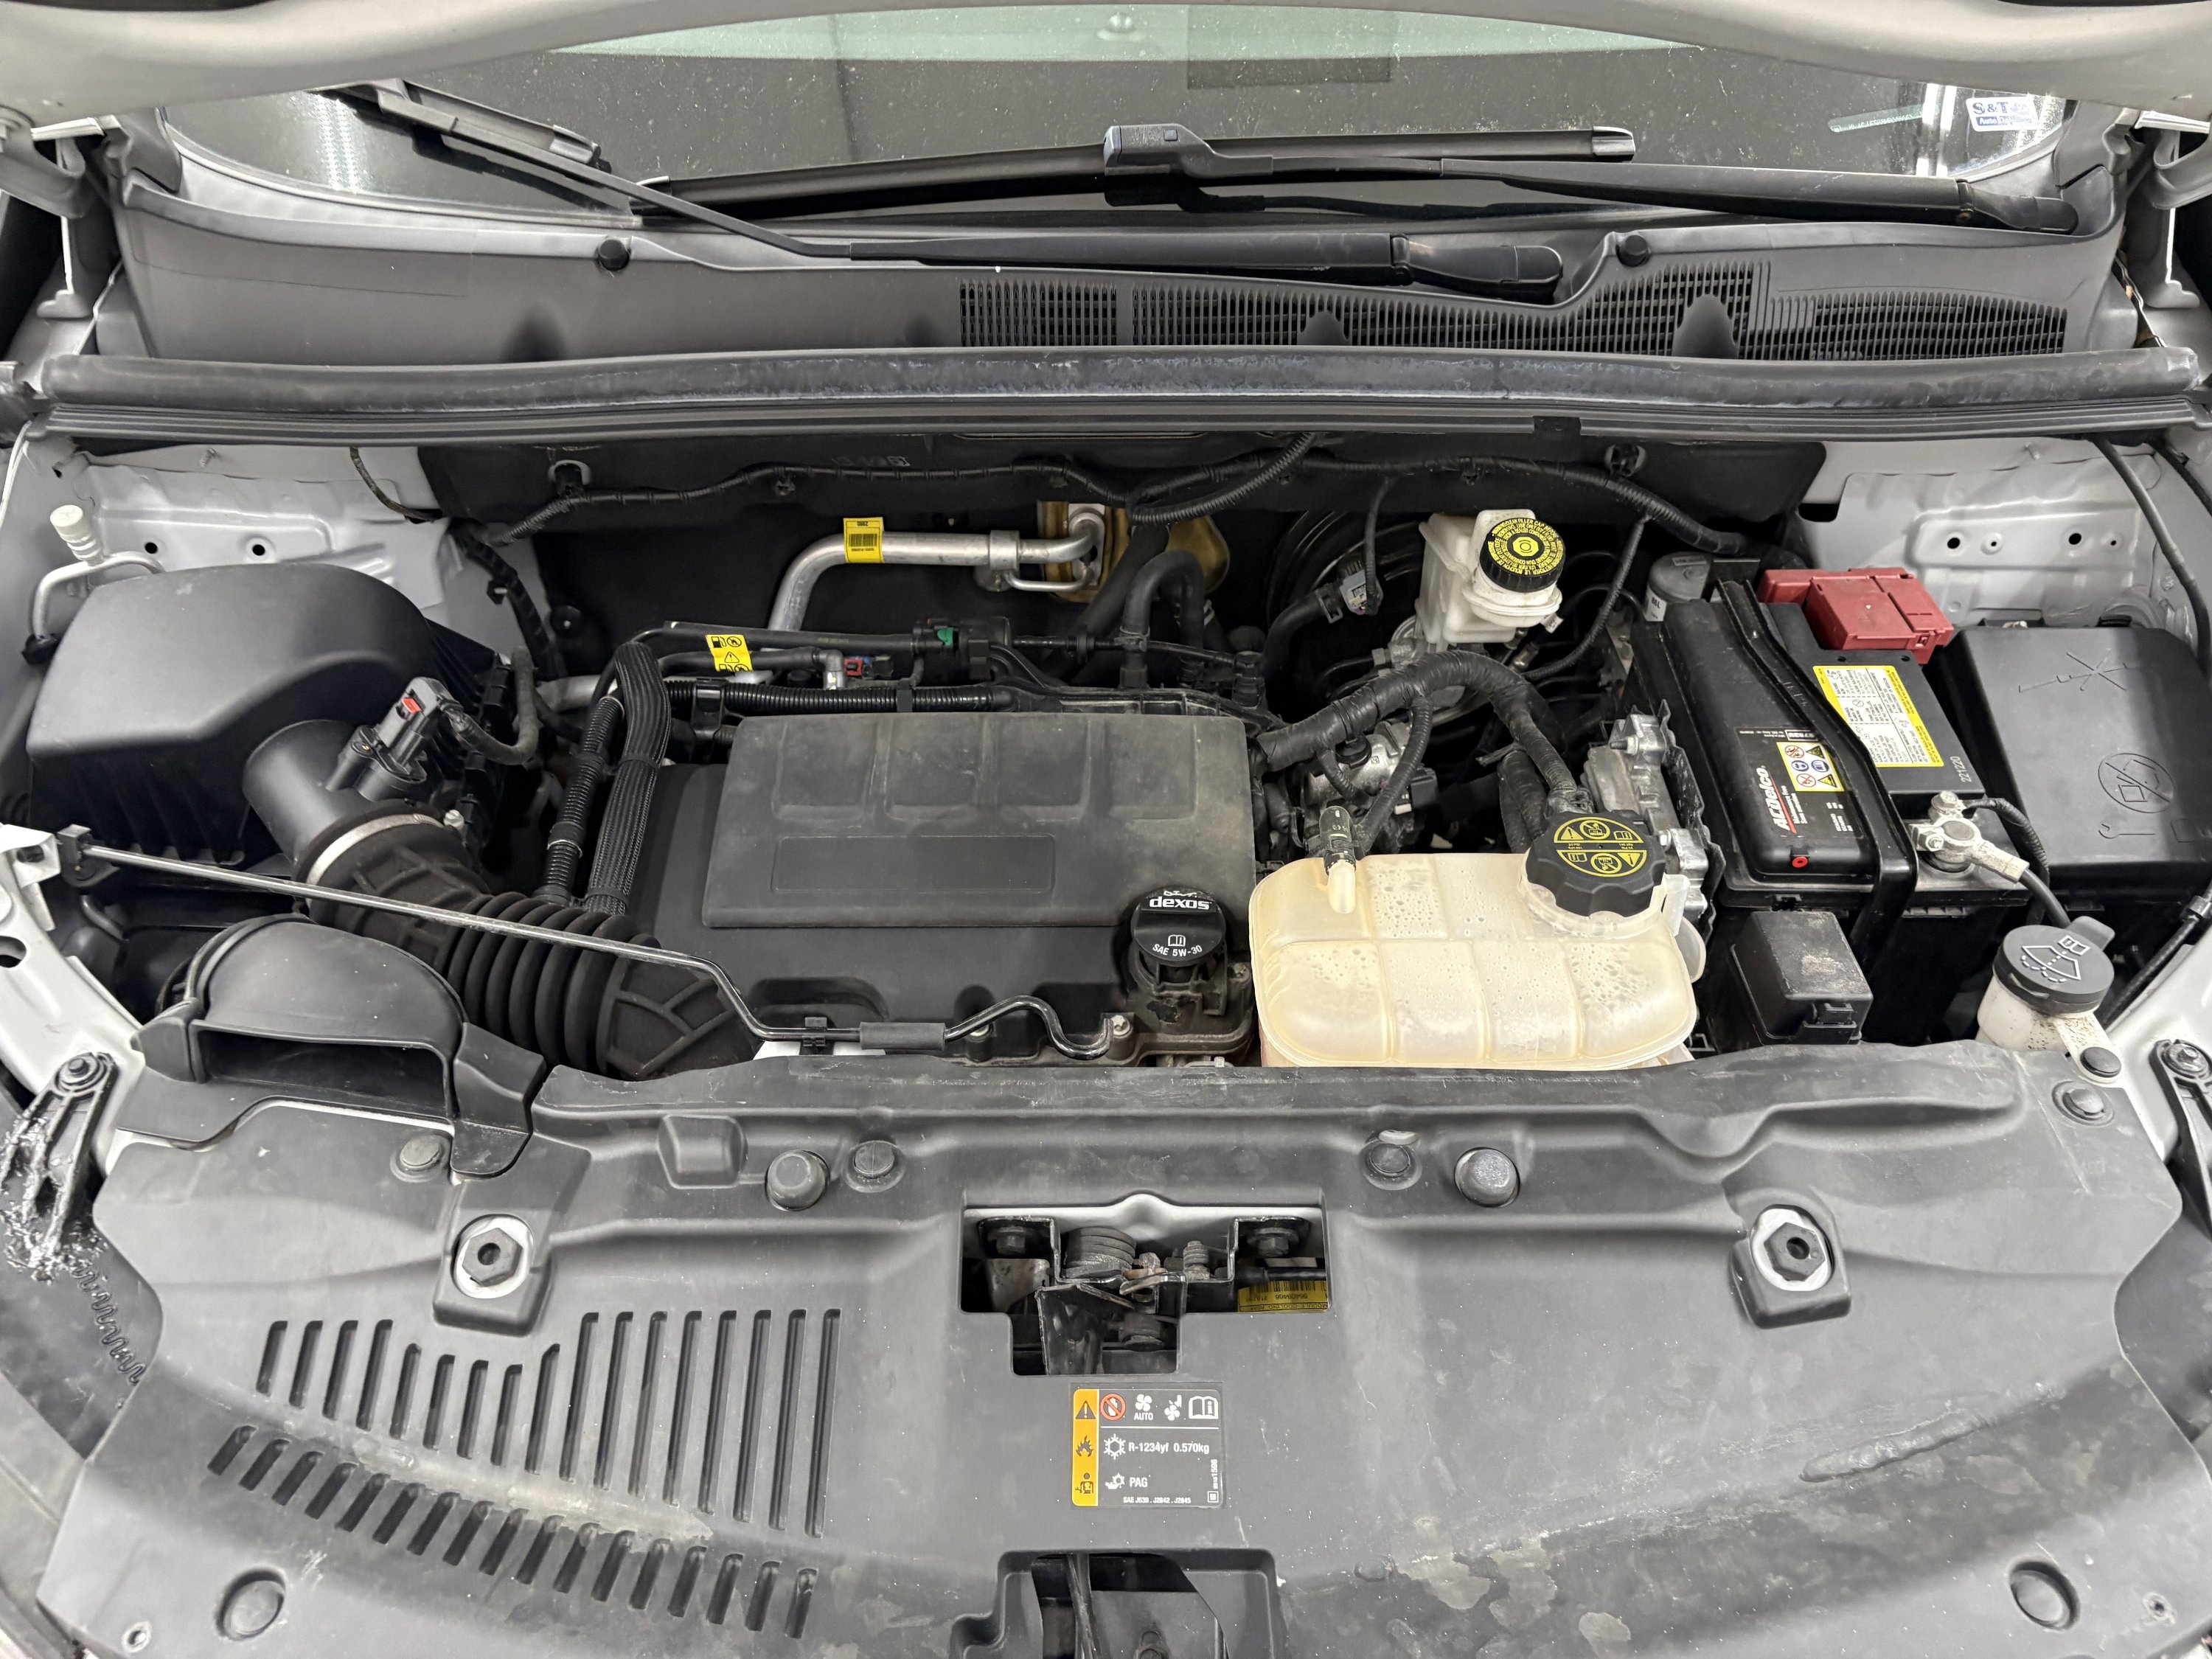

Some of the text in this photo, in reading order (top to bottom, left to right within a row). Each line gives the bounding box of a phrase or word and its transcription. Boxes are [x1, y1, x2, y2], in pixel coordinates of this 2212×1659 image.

[1950, 756, 1972, 783] 221220
[1150, 896, 1209, 911] dexos
[1152, 944, 1203, 957] SAE 5W-30
[1134, 1413, 1154, 1421] AUTO
[1129, 1442, 1210, 1455] R-1234yf 0.570kg
[1130, 1478, 1148, 1487] PAG
